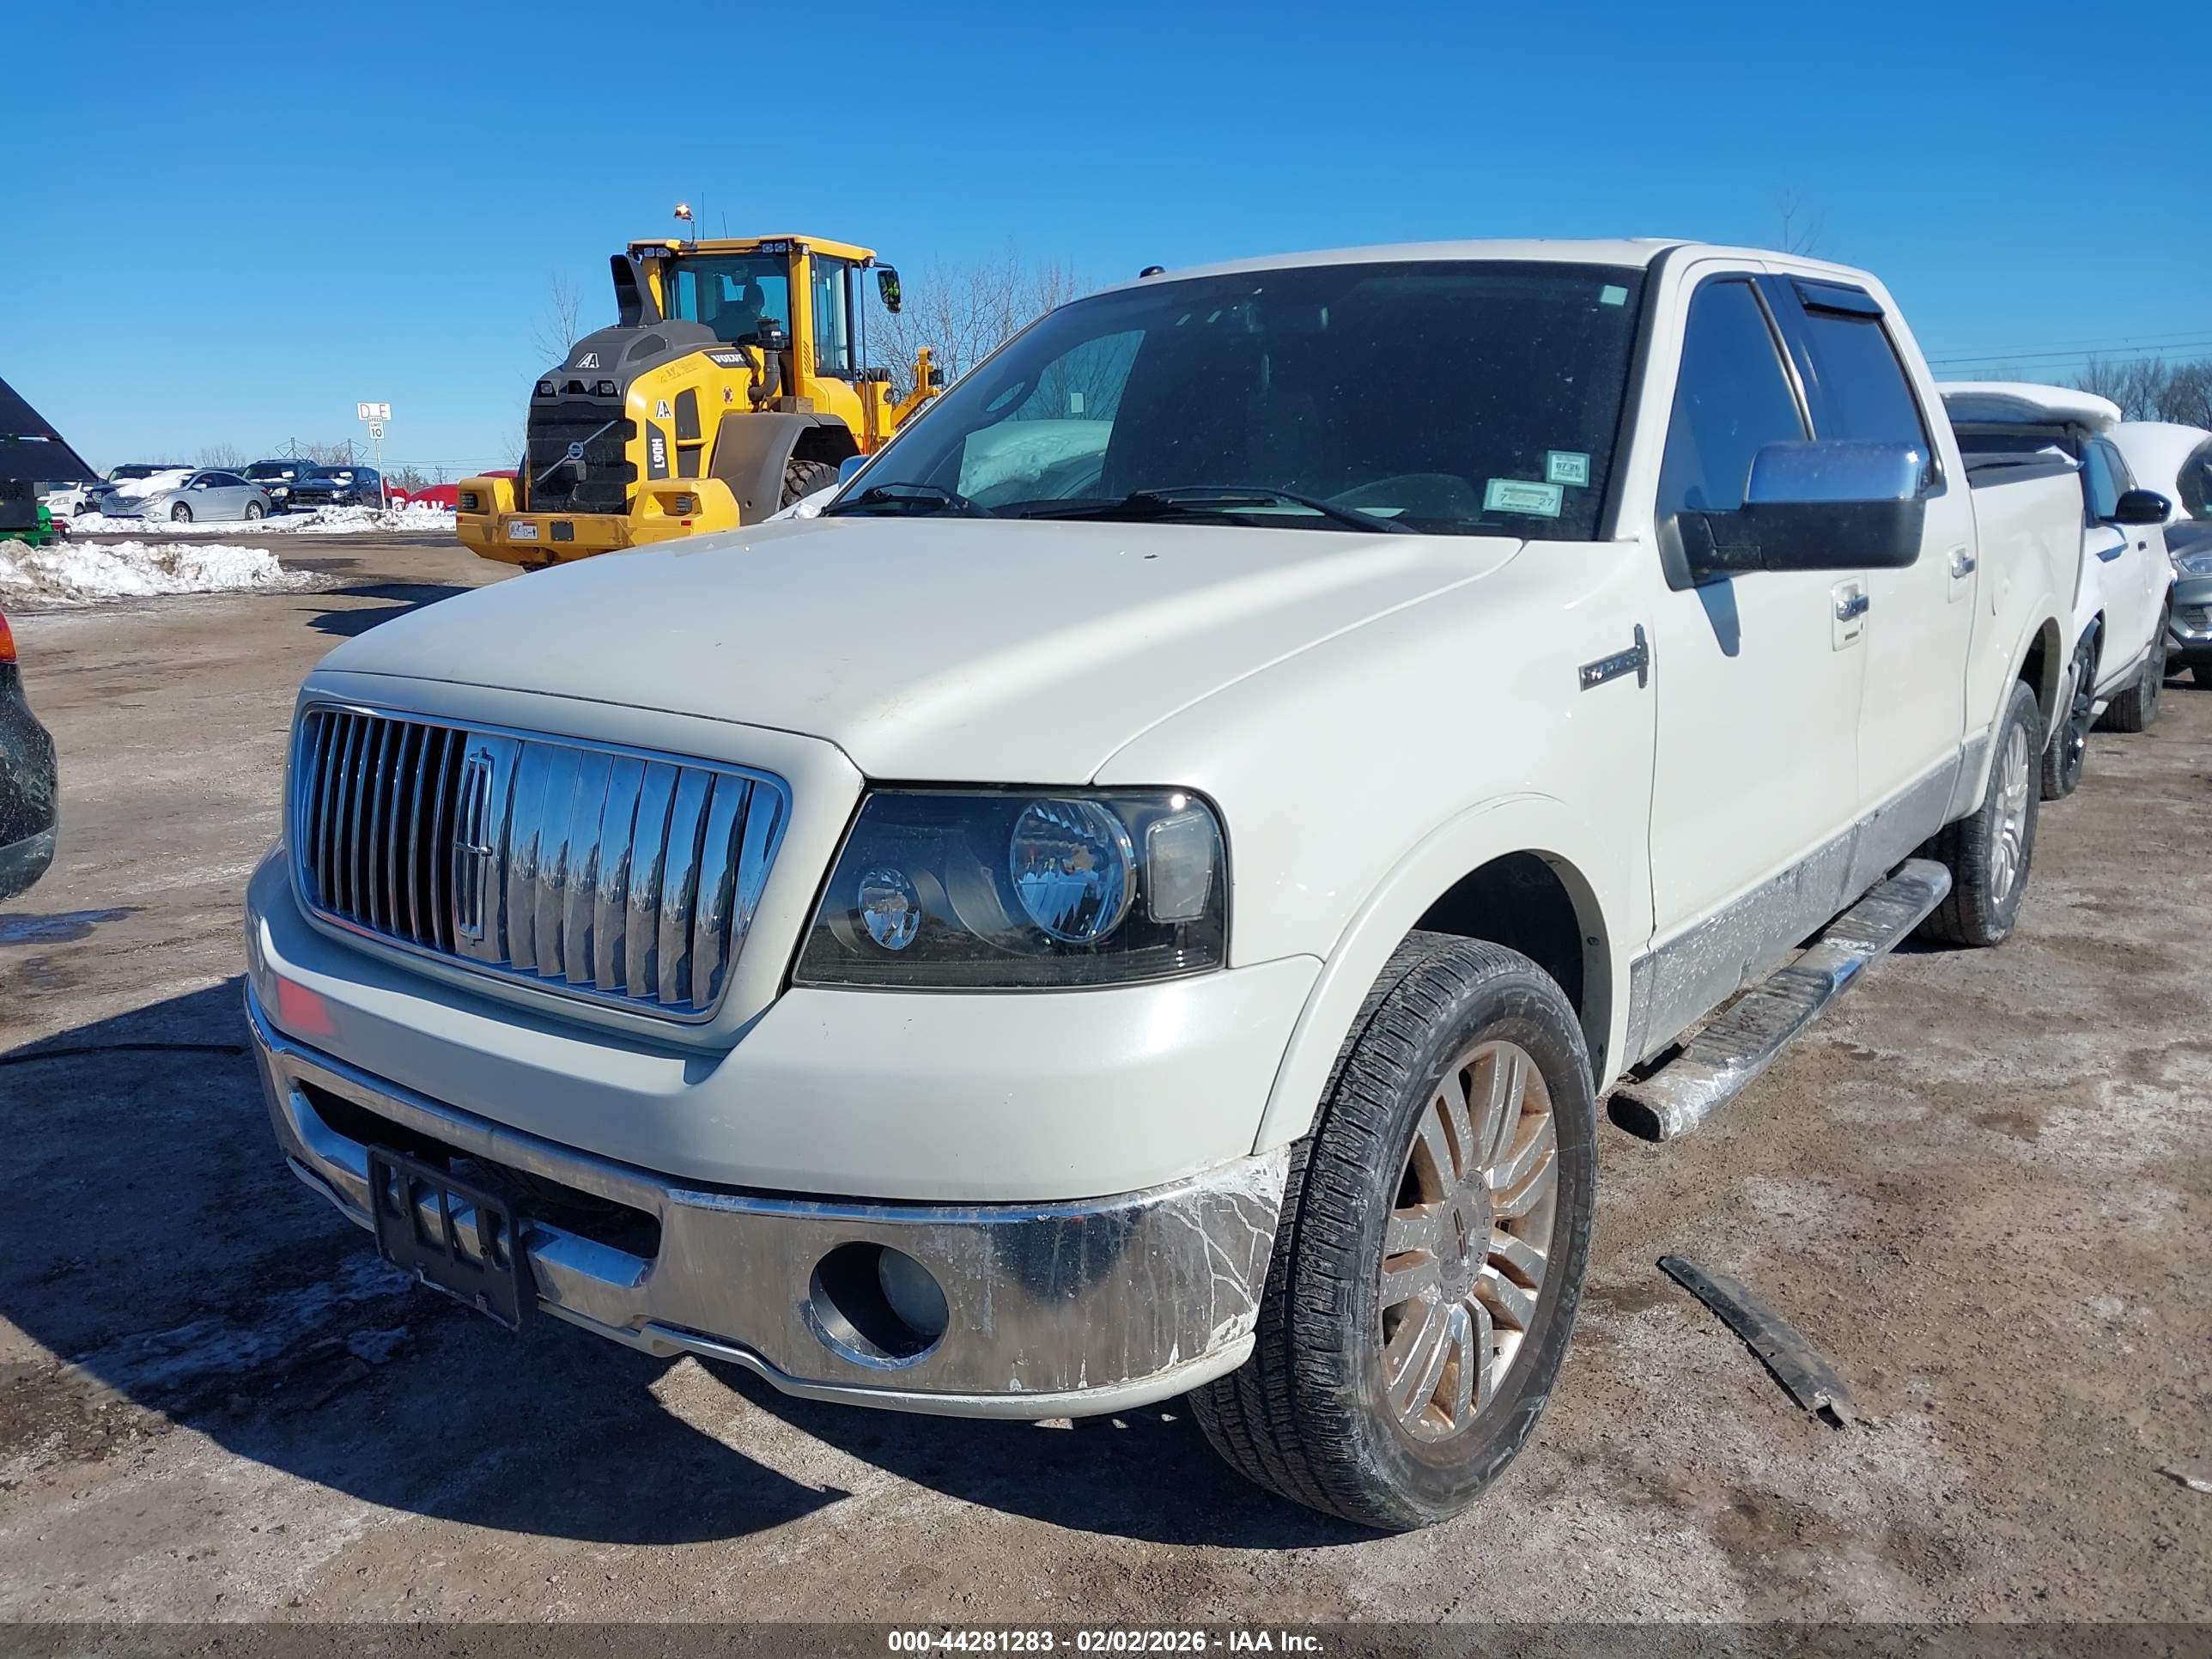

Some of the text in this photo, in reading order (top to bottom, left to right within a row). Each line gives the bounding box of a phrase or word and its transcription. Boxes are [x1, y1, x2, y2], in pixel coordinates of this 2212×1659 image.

[372, 428, 382, 437] 10
[651, 438, 665, 468] L90H
[1500, 494, 1507, 502] 7
[1539, 498, 1554, 507] 27
